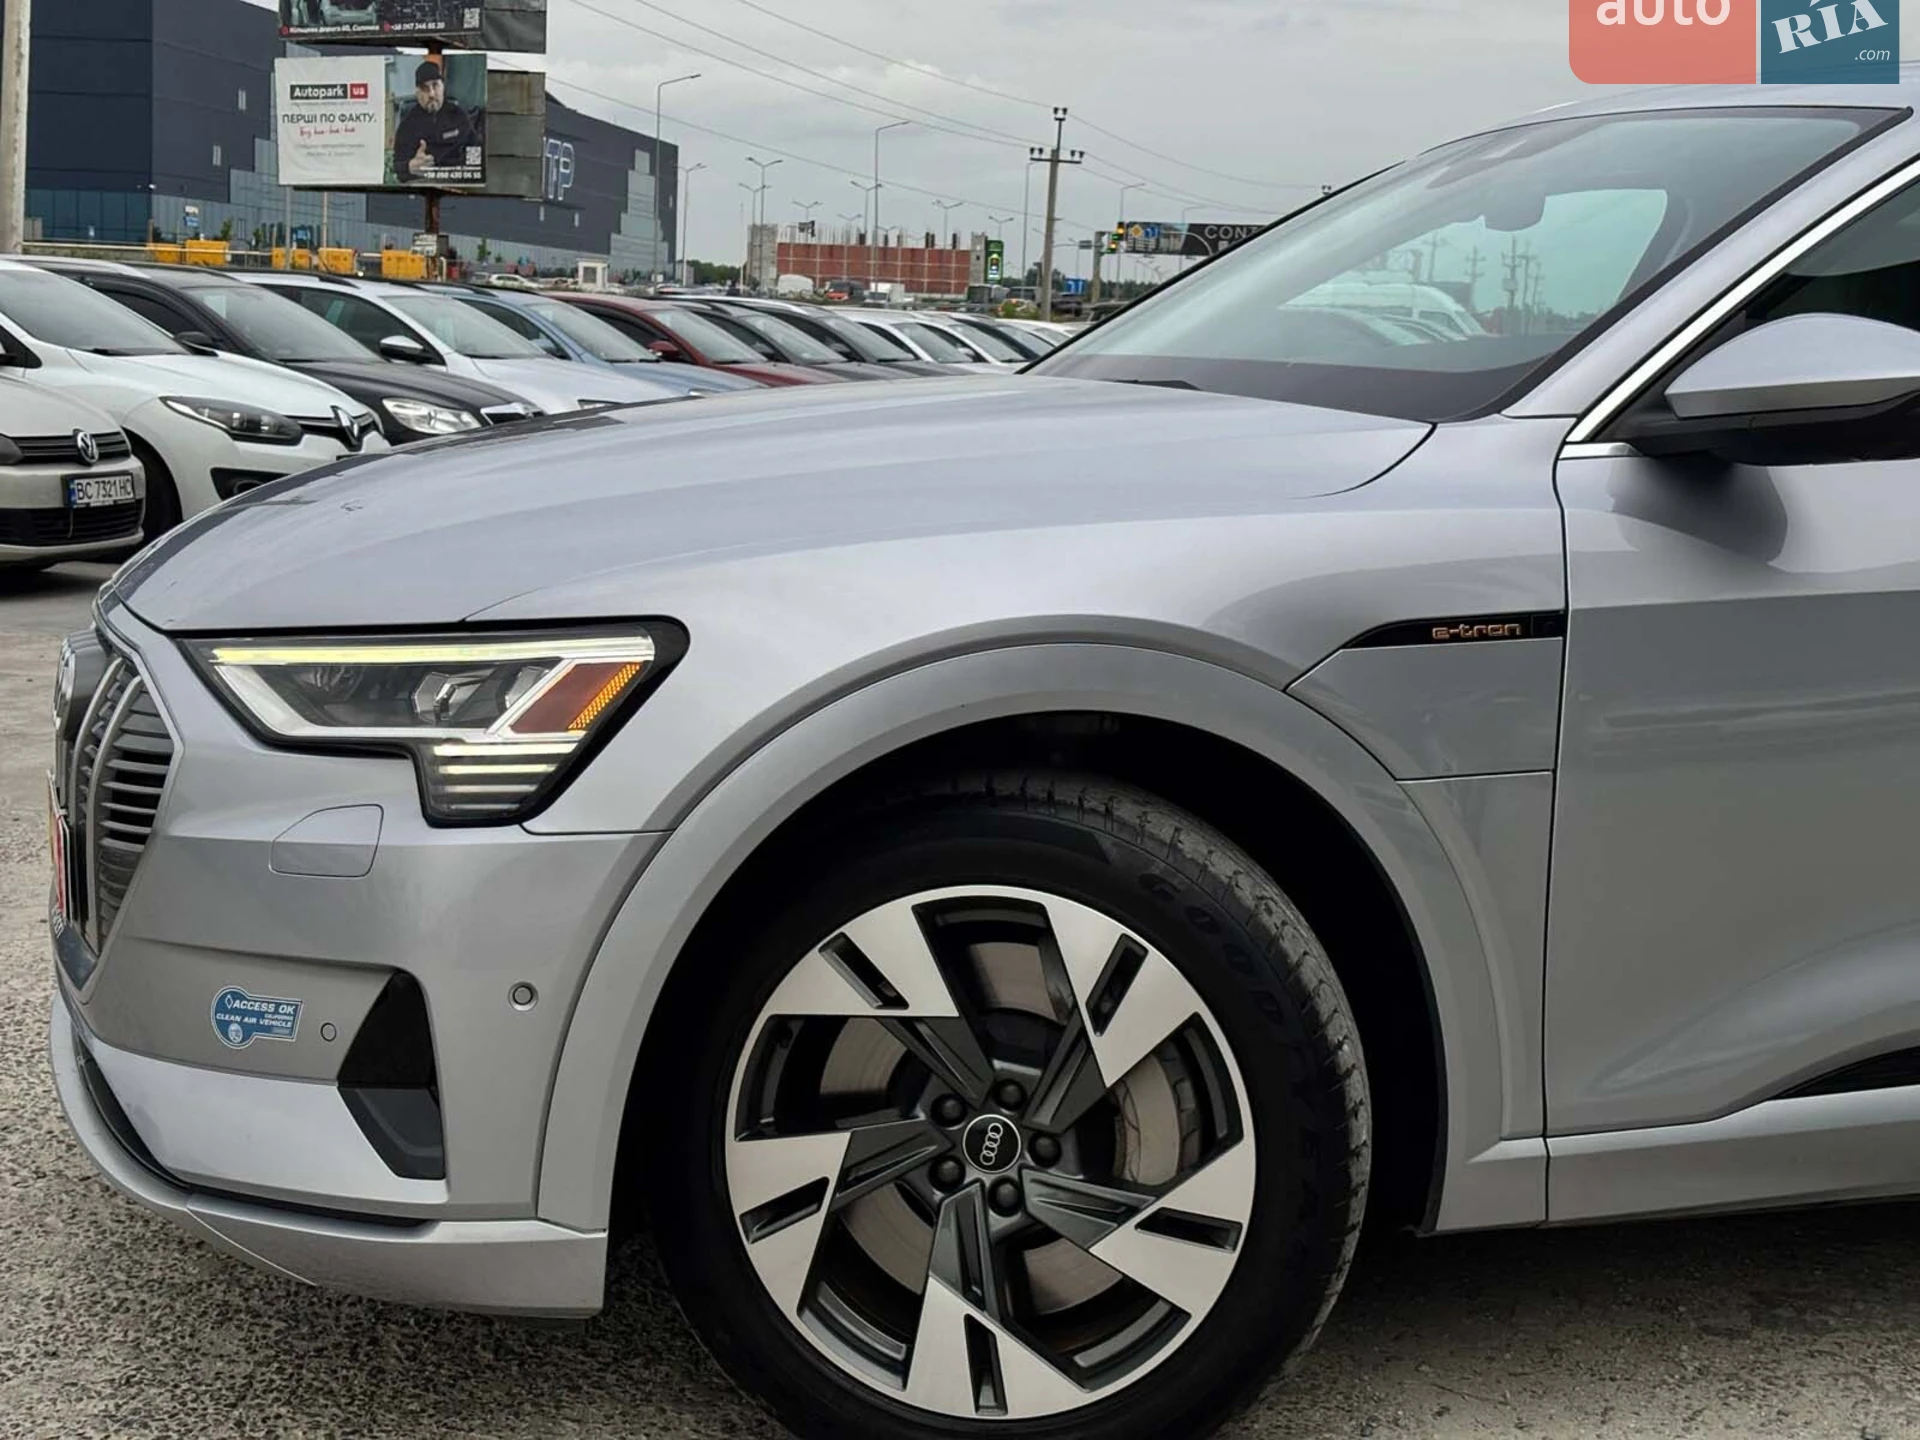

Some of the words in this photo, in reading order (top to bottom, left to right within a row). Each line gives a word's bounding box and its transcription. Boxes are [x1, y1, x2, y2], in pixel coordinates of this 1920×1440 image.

[293, 85, 344, 99] Autopark
[282, 113, 317, 123] ПЕРШІ
[319, 113, 336, 123] ПО
[338, 112, 377, 123] ФАКТУ.
[76, 482, 93, 500] BC
[95, 480, 118, 499] 7321
[1432, 623, 1522, 640] e-tron
[232, 1000, 276, 1012] ACCESS
[278, 1004, 296, 1015] OK
[216, 1013, 242, 1022] CLEAN
[243, 1016, 257, 1024] AIR
[259, 1019, 293, 1028] VEHICLE
